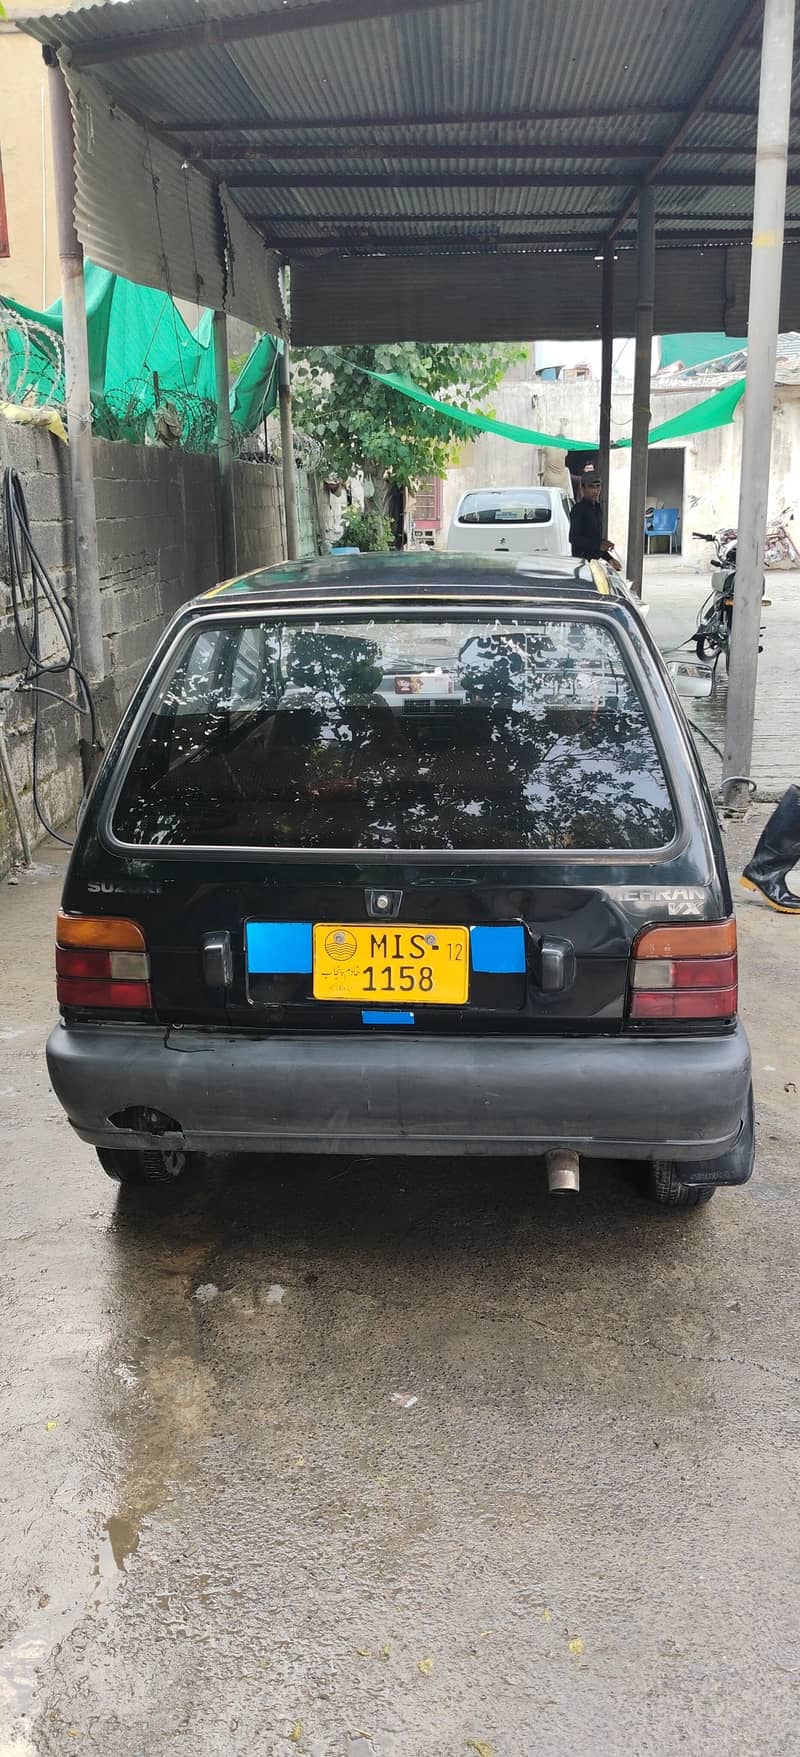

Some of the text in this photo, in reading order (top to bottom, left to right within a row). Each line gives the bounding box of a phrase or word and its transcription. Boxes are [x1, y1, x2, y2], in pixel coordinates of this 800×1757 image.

[667, 902, 705, 916] VX
[447, 943, 463, 961] 12
[362, 966, 434, 992] 1158
